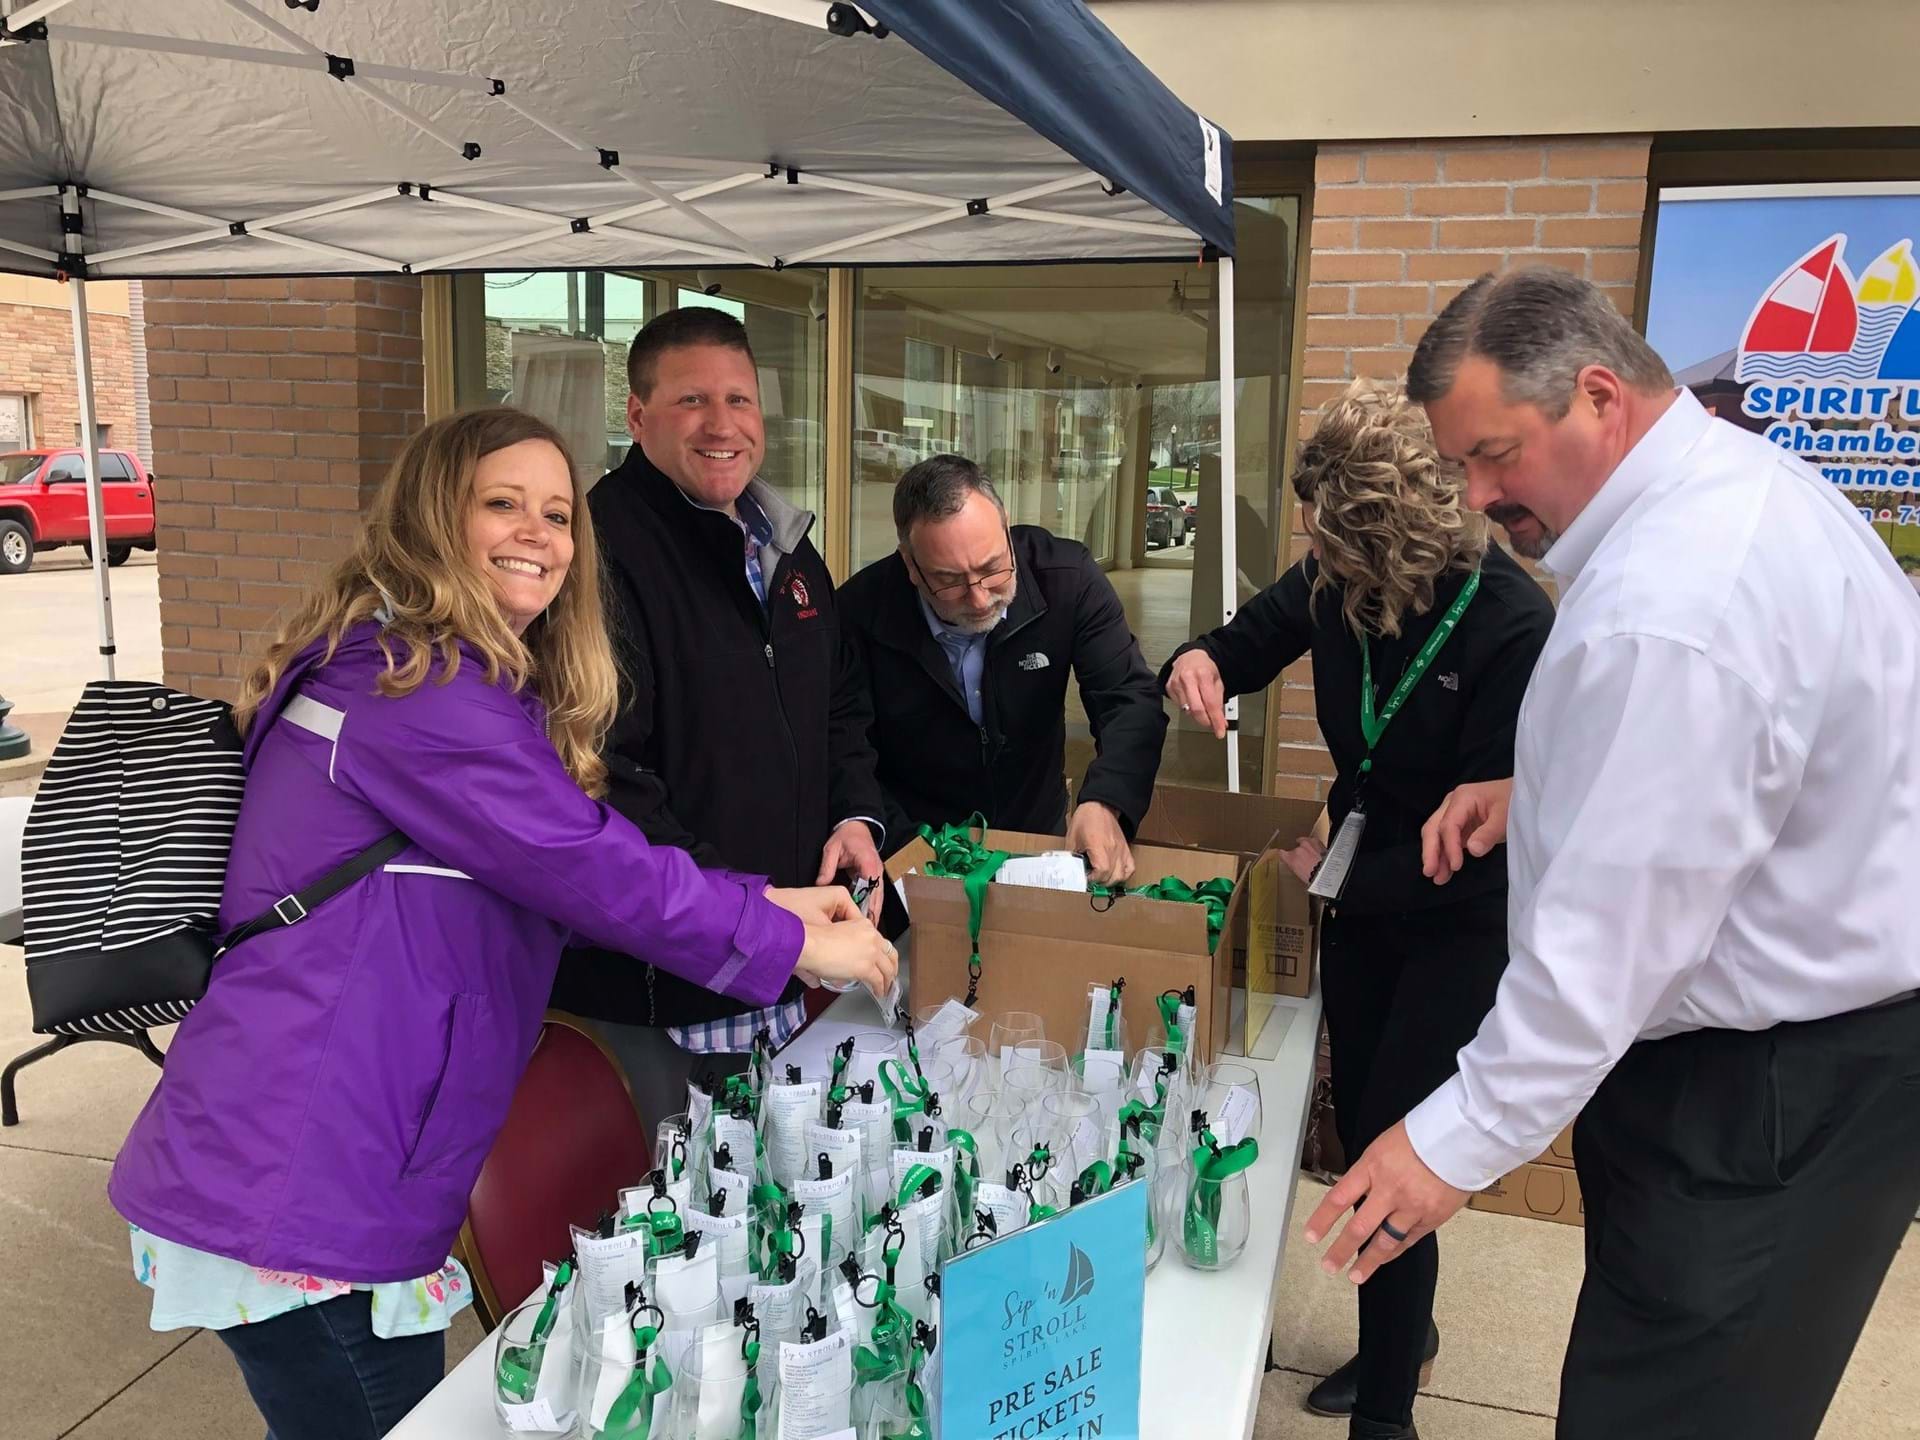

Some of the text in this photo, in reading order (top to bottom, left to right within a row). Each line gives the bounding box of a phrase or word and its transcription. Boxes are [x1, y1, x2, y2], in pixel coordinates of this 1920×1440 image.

[1747, 386, 1891, 415] SPIRIT
[1768, 426, 1920, 453] Chambe
[1002, 1291, 1033, 1330] Sip
[1003, 1305, 1087, 1358] STROLL
[1003, 1343, 1047, 1370] SPIRIT
[988, 1347, 1102, 1425] PRE SALE
[1077, 1414, 1104, 1440] IN
